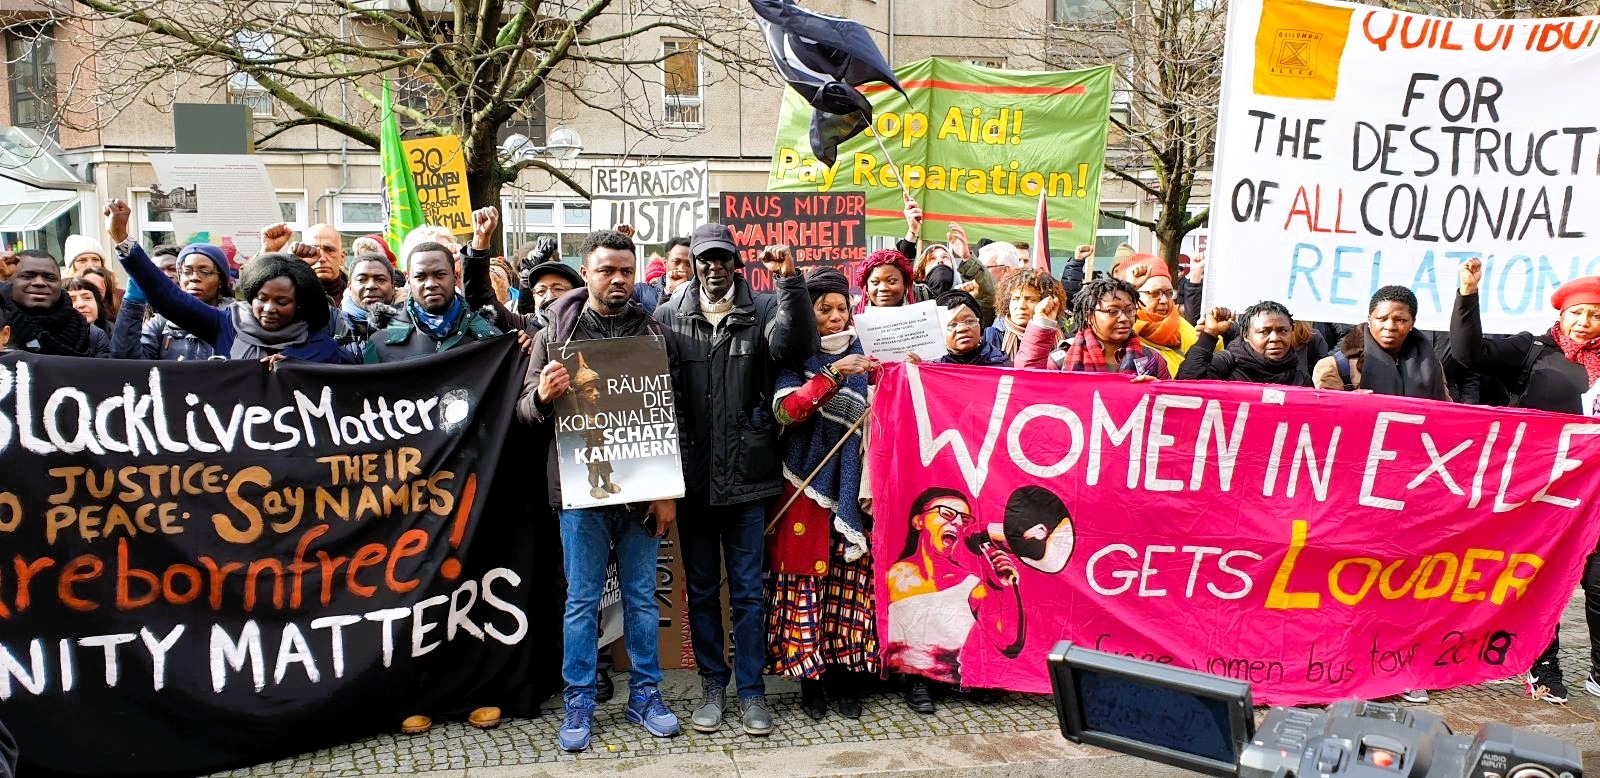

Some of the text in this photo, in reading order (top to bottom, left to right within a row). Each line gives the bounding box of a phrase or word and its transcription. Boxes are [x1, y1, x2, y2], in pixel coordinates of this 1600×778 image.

[1401, 72, 1504, 123] FOR
[937, 106, 1024, 146] Aid!
[1248, 109, 1327, 160] THE
[410, 147, 443, 175] 30
[775, 147, 1089, 199] Pay Reparation!
[416, 185, 461, 204] OTE
[597, 166, 706, 199] REPARATORY
[610, 200, 705, 242] JUSTICE
[726, 195, 866, 218] RAUS MIT DER
[1231, 177, 1587, 243] OF ALL COLONIAL
[728, 219, 861, 247] WAHRHEIT
[796, 247, 867, 262] DEUTSCHE
[1287, 242, 1600, 316] RELATION
[607, 374, 671, 396] RÄUMT
[643, 391, 673, 408] DIE
[558, 407, 674, 433] KOLONIALEN
[602, 423, 677, 445] SCHATZ
[905, 362, 1250, 499] WOMEN
[1262, 421, 1342, 502] IN
[316, 447, 422, 486] THEIR
[574, 439, 678, 465] KAMMERN
[211, 465, 305, 543] Say
[315, 470, 455, 520] NAMES
[1086, 519, 1545, 609] GETS LOUDER
[209, 567, 528, 693] MATTERS
[1306, 641, 1355, 684] bus
[1434, 630, 1517, 668] 2018
[1483, 753, 1507, 763] AUDIO
